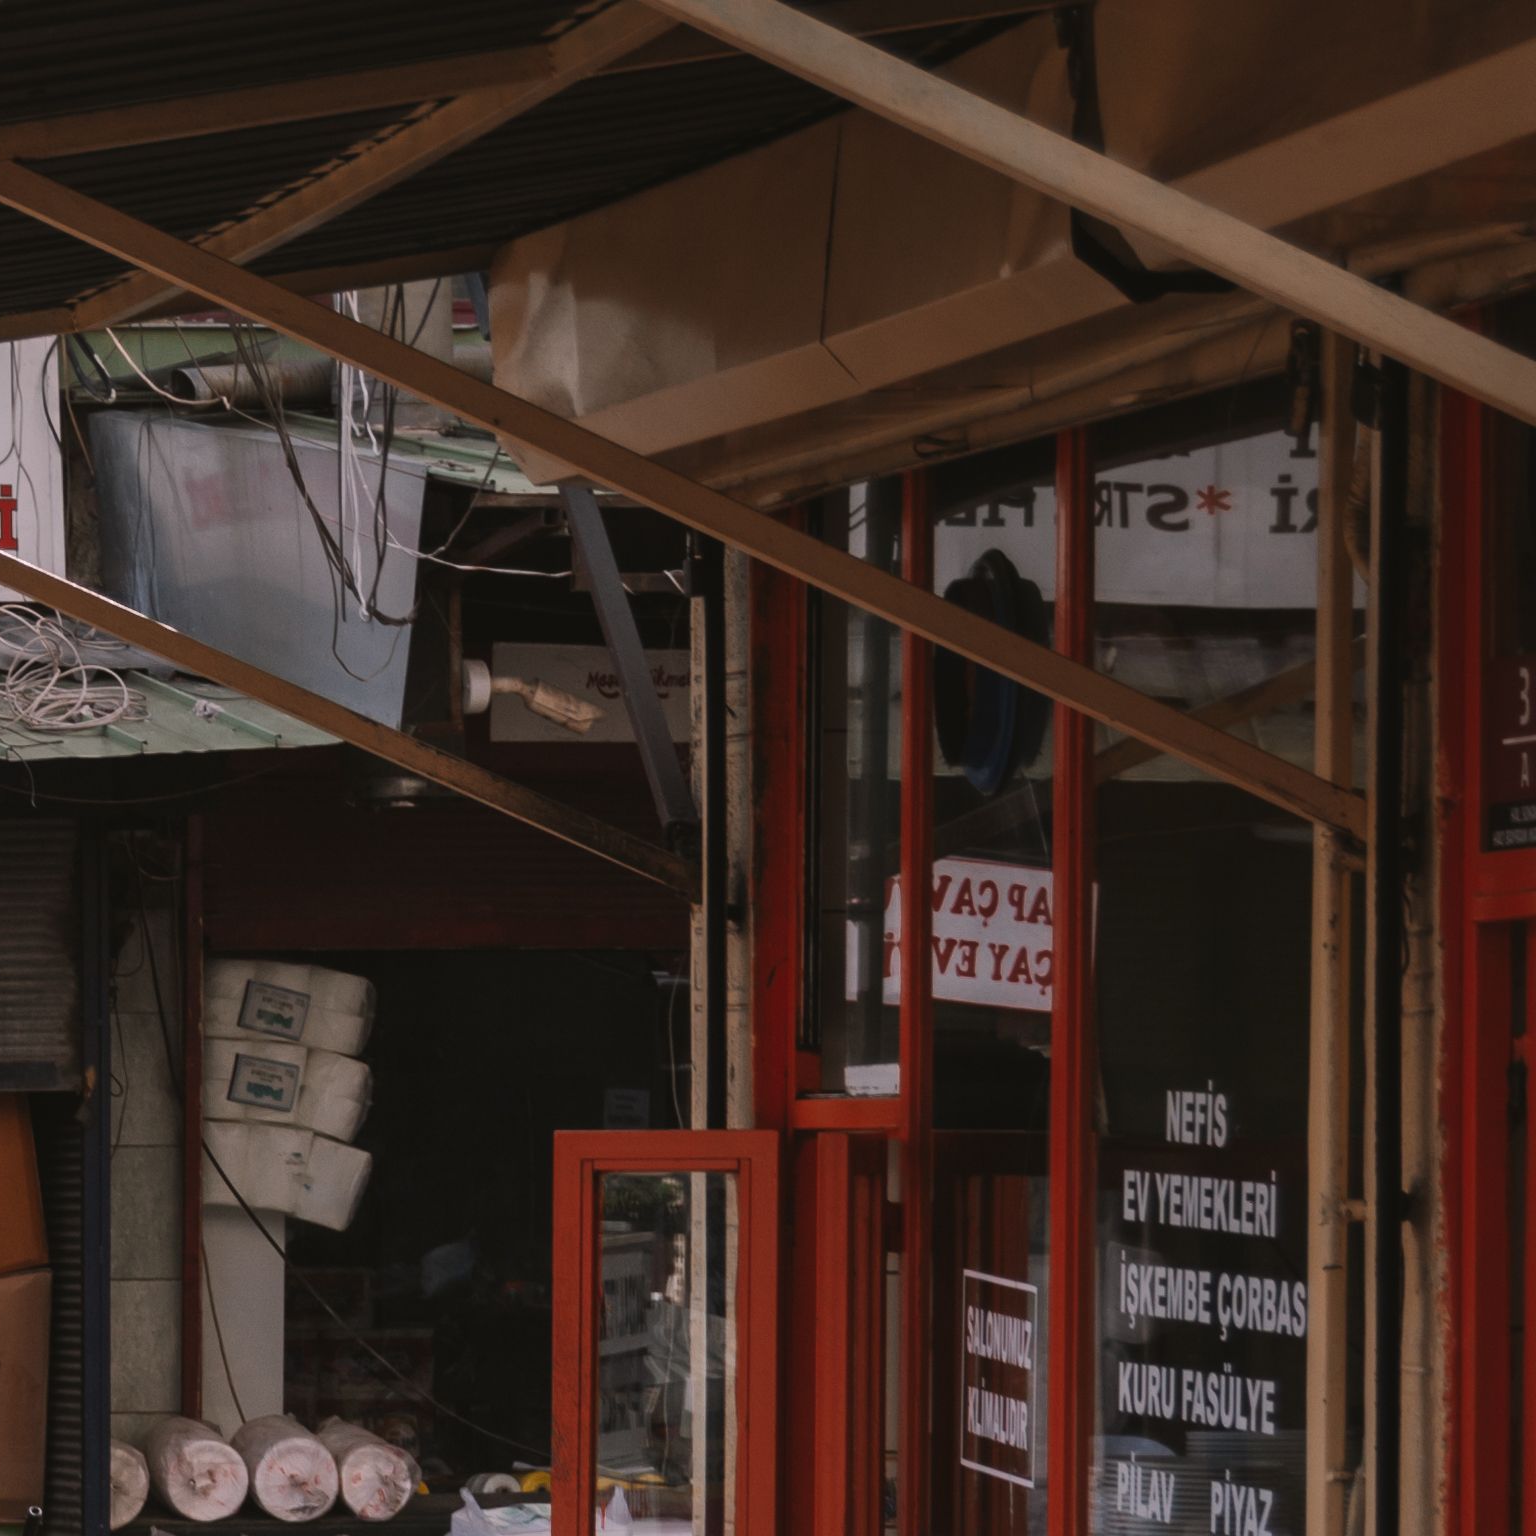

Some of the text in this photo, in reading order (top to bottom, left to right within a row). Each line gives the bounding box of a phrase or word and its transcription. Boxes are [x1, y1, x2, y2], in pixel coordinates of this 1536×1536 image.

[1166, 1079, 1228, 1148] NEFİS
[1123, 1169, 1276, 1238] EV YEMEKLERİ
[1120, 1249, 1307, 1341] İŞKEMBE ÇORBAS
[966, 1304, 1032, 1370] SALONUMUZ
[967, 1376, 1028, 1451] KLİMALIDIR
[1118, 1361, 1275, 1435] KURU FASÜLYE
[1117, 1451, 1175, 1524] PİLAV
